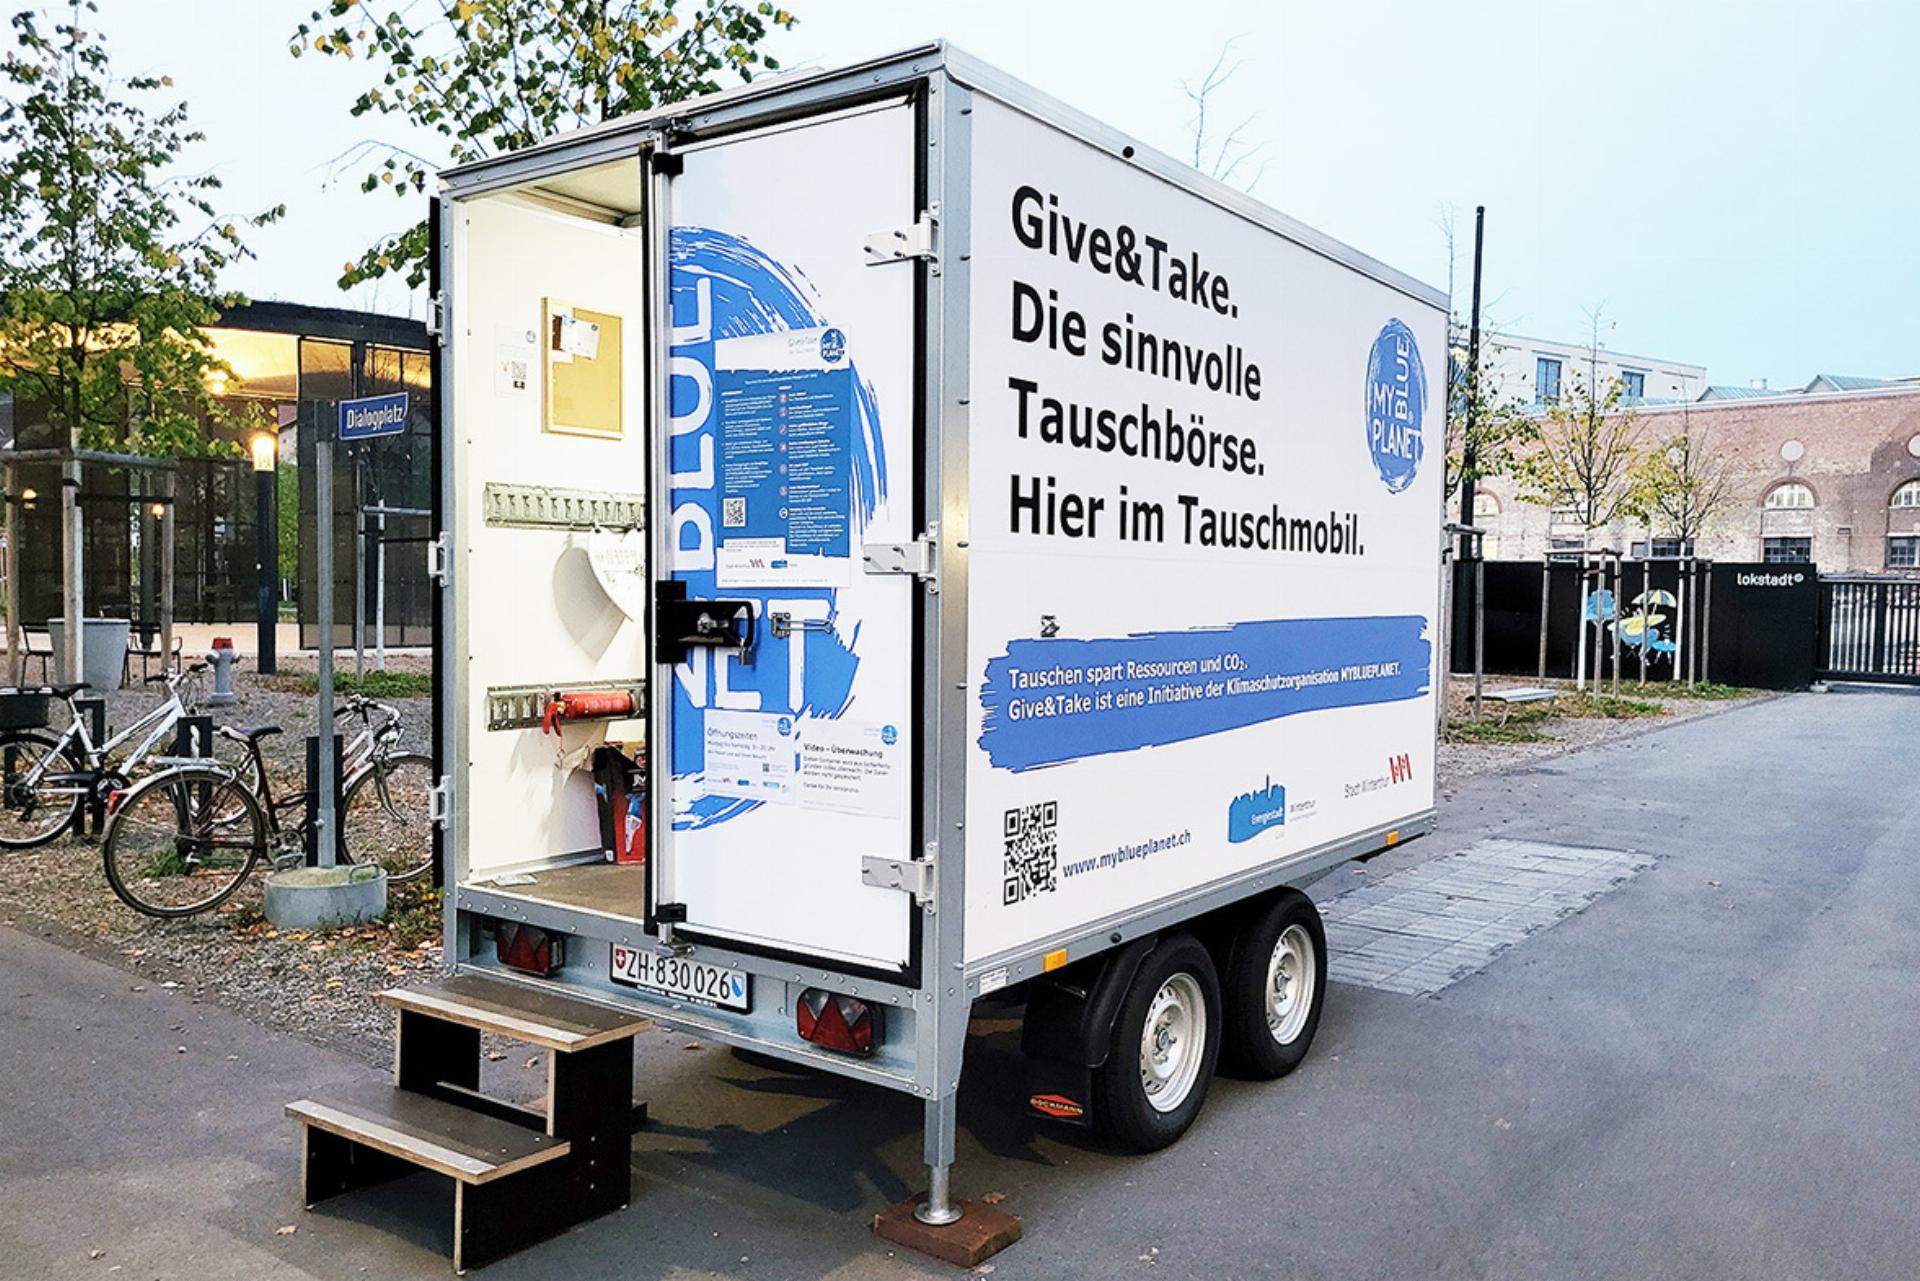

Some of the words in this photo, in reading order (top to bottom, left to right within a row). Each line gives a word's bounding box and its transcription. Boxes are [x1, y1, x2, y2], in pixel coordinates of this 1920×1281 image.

[1011, 185, 1239, 319] Give&Take.
[1012, 280, 1086, 357] Die
[1101, 313, 1262, 401] sinnvolle
[1373, 381, 1395, 417] MY
[1394, 336, 1411, 420] BLUE
[346, 404, 403, 431] Dialogplatz
[1008, 377, 1264, 476] Tauschbörse.
[1372, 418, 1421, 461] PLANET
[1010, 474, 1104, 538] Hier
[1119, 485, 1164, 543] im
[1178, 495, 1364, 556] Tauschmobil.
[1737, 572, 1794, 586] lokstadt
[1008, 665, 1082, 689] Tauschen
[1086, 664, 1124, 686] spart
[1127, 659, 1197, 679] Ressourcen
[1200, 655, 1222, 673] und
[1008, 693, 1091, 721] Give&Take
[1095, 691, 1113, 711] ist
[1116, 689, 1145, 707] eine
[1147, 682, 1202, 705] Initiative
[1205, 680, 1225, 697] der
[1226, 670, 1339, 695] Klimaschutzorganisation
[1340, 662, 1401, 682] MYBLUEPLANET.
[1062, 829, 1191, 877] www.myblueplanet.ch
